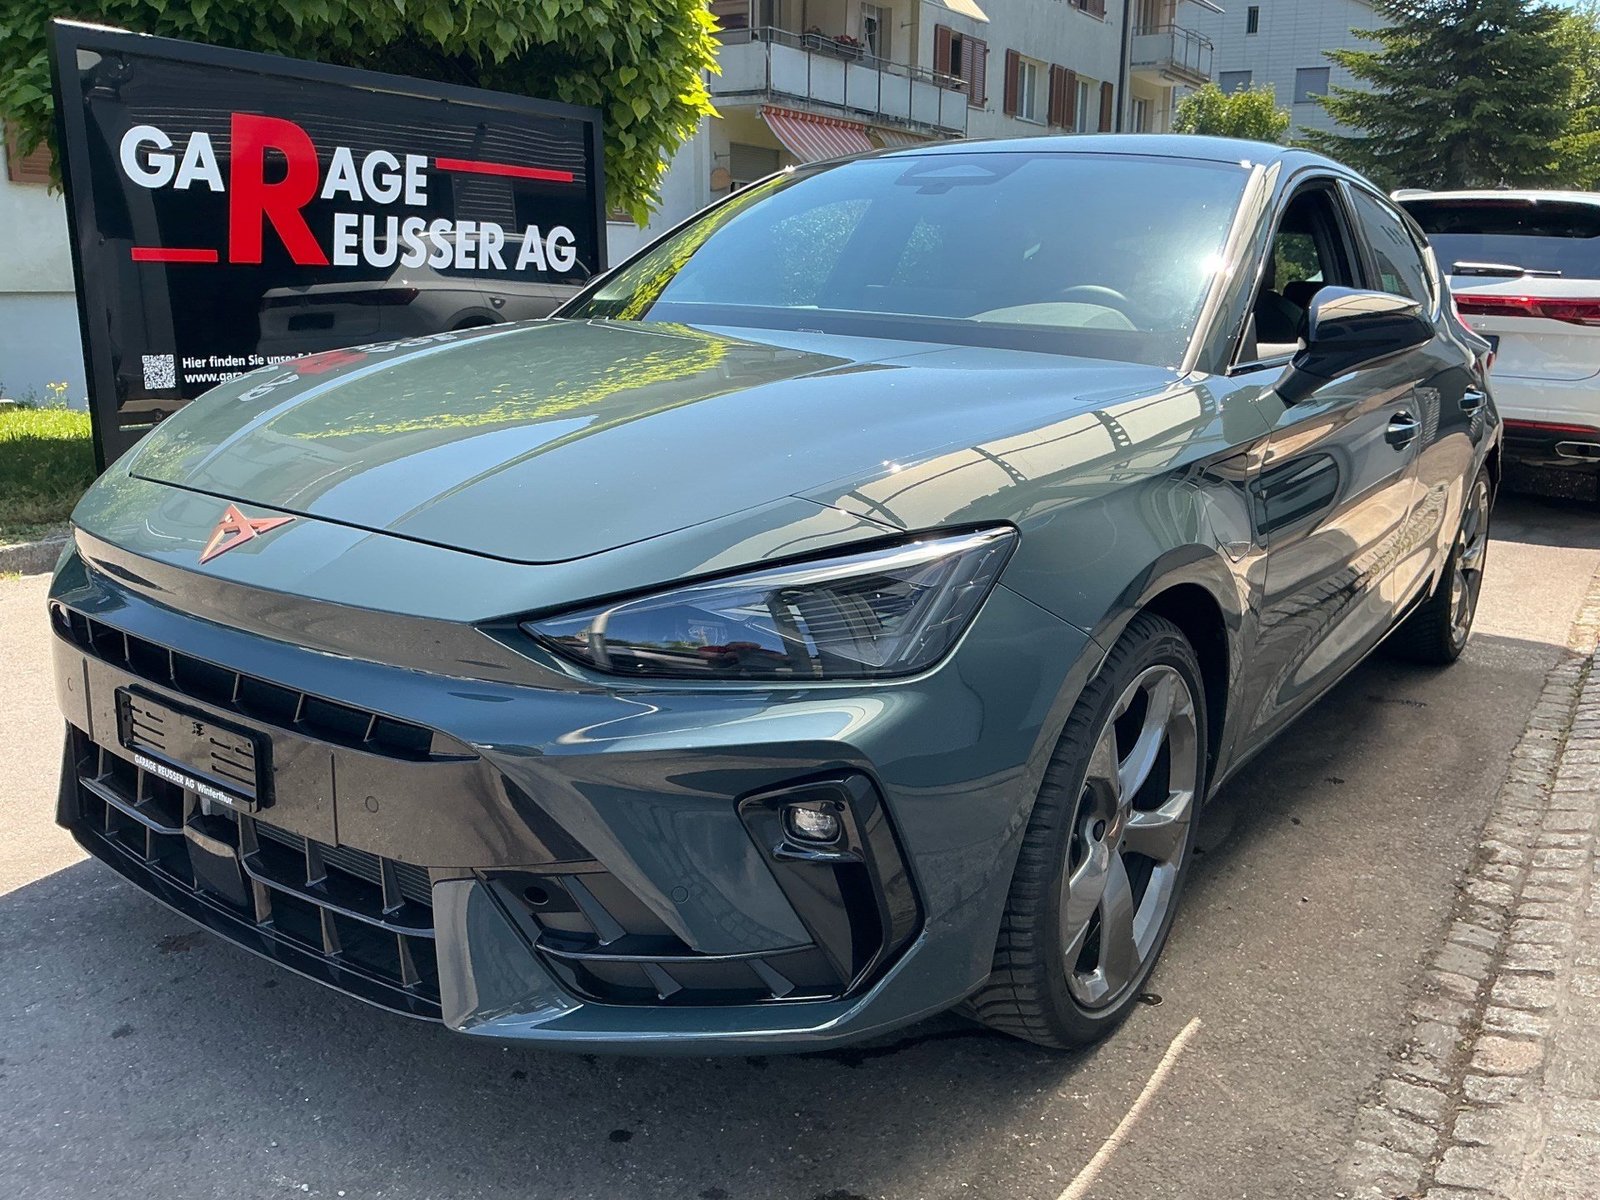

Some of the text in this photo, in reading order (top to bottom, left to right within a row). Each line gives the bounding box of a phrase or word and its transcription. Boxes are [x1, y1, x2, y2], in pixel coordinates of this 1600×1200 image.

[119, 112, 428, 265] GARAGE
[514, 224, 577, 273] AG
[182, 357, 207, 369] Hier
[209, 354, 246, 368] finden
[248, 354, 264, 366] Sie
[134, 754, 233, 805] GARAGE REUSSER AG Winterthur
